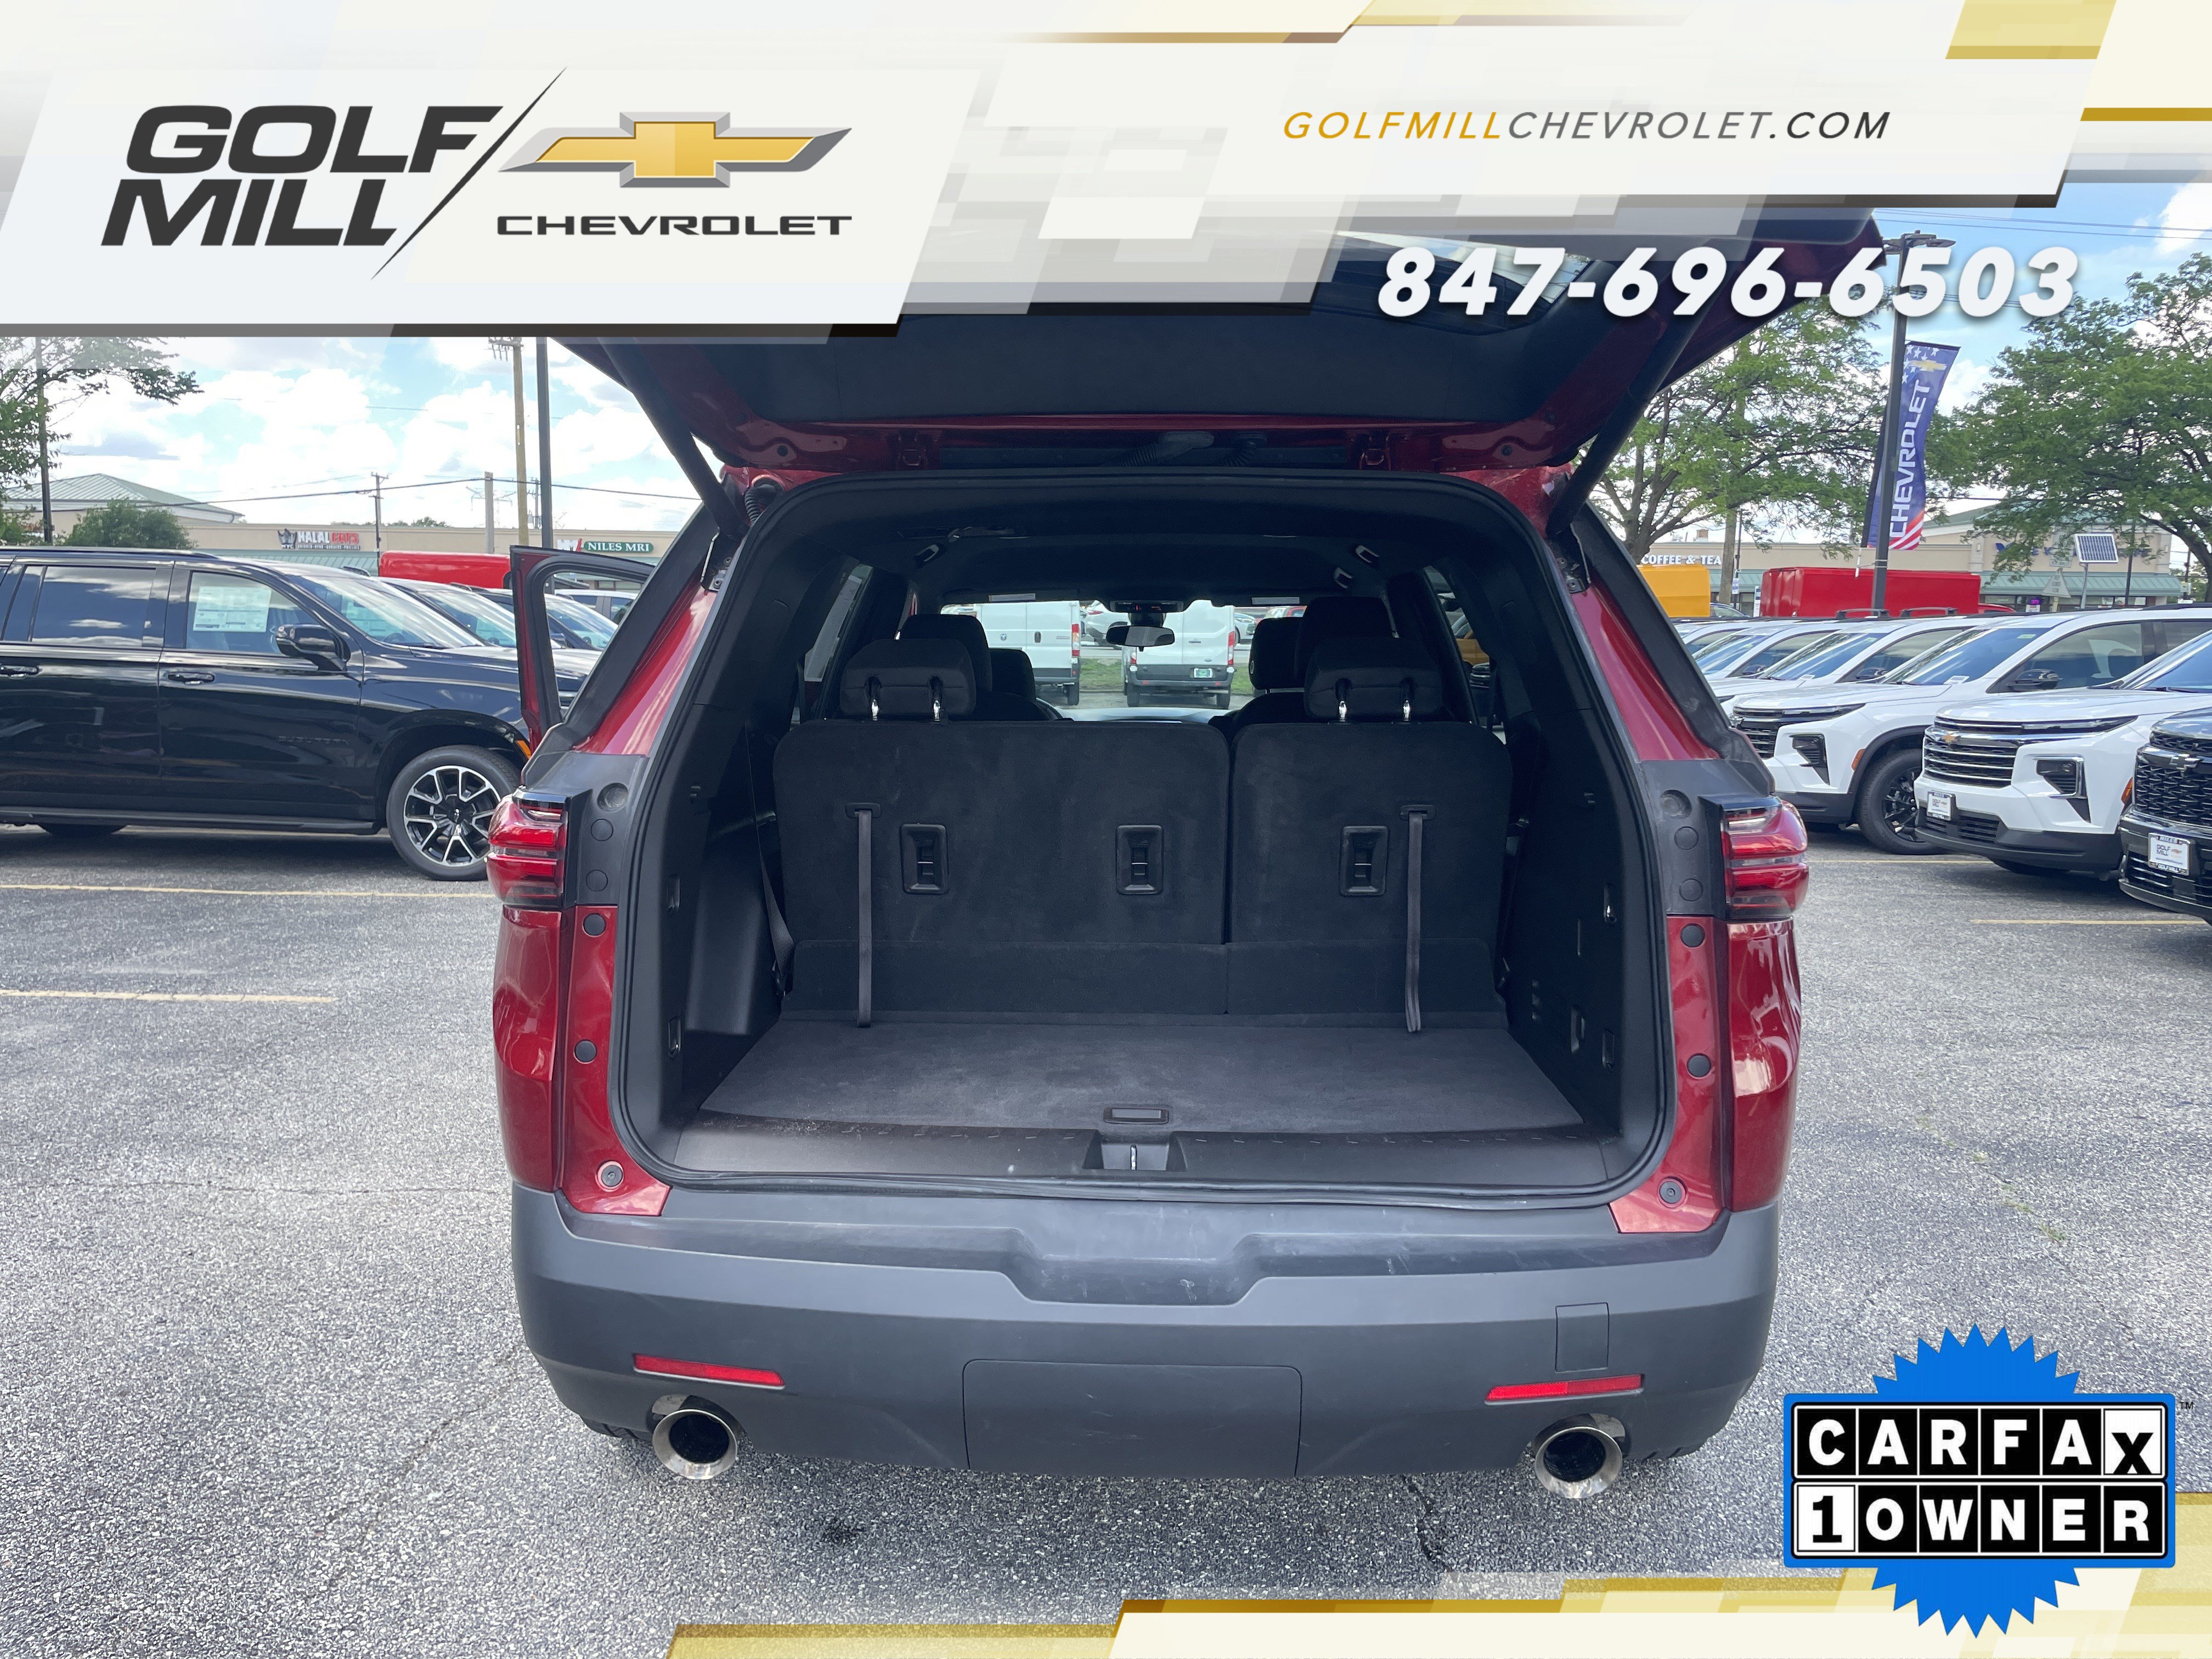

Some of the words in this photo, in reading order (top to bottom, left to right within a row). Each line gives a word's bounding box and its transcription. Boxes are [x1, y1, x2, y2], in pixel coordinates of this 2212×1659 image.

[1889, 379, 1930, 538] CHEVROLET
[297, 531, 330, 544] HALAL
[331, 532, 359, 544] EATS
[588, 542, 622, 551] NILES
[625, 543, 650, 552] MRI
[1640, 554, 1681, 565] COFFEE
[1685, 555, 1696, 565] &
[1700, 555, 1722, 565] TEA
